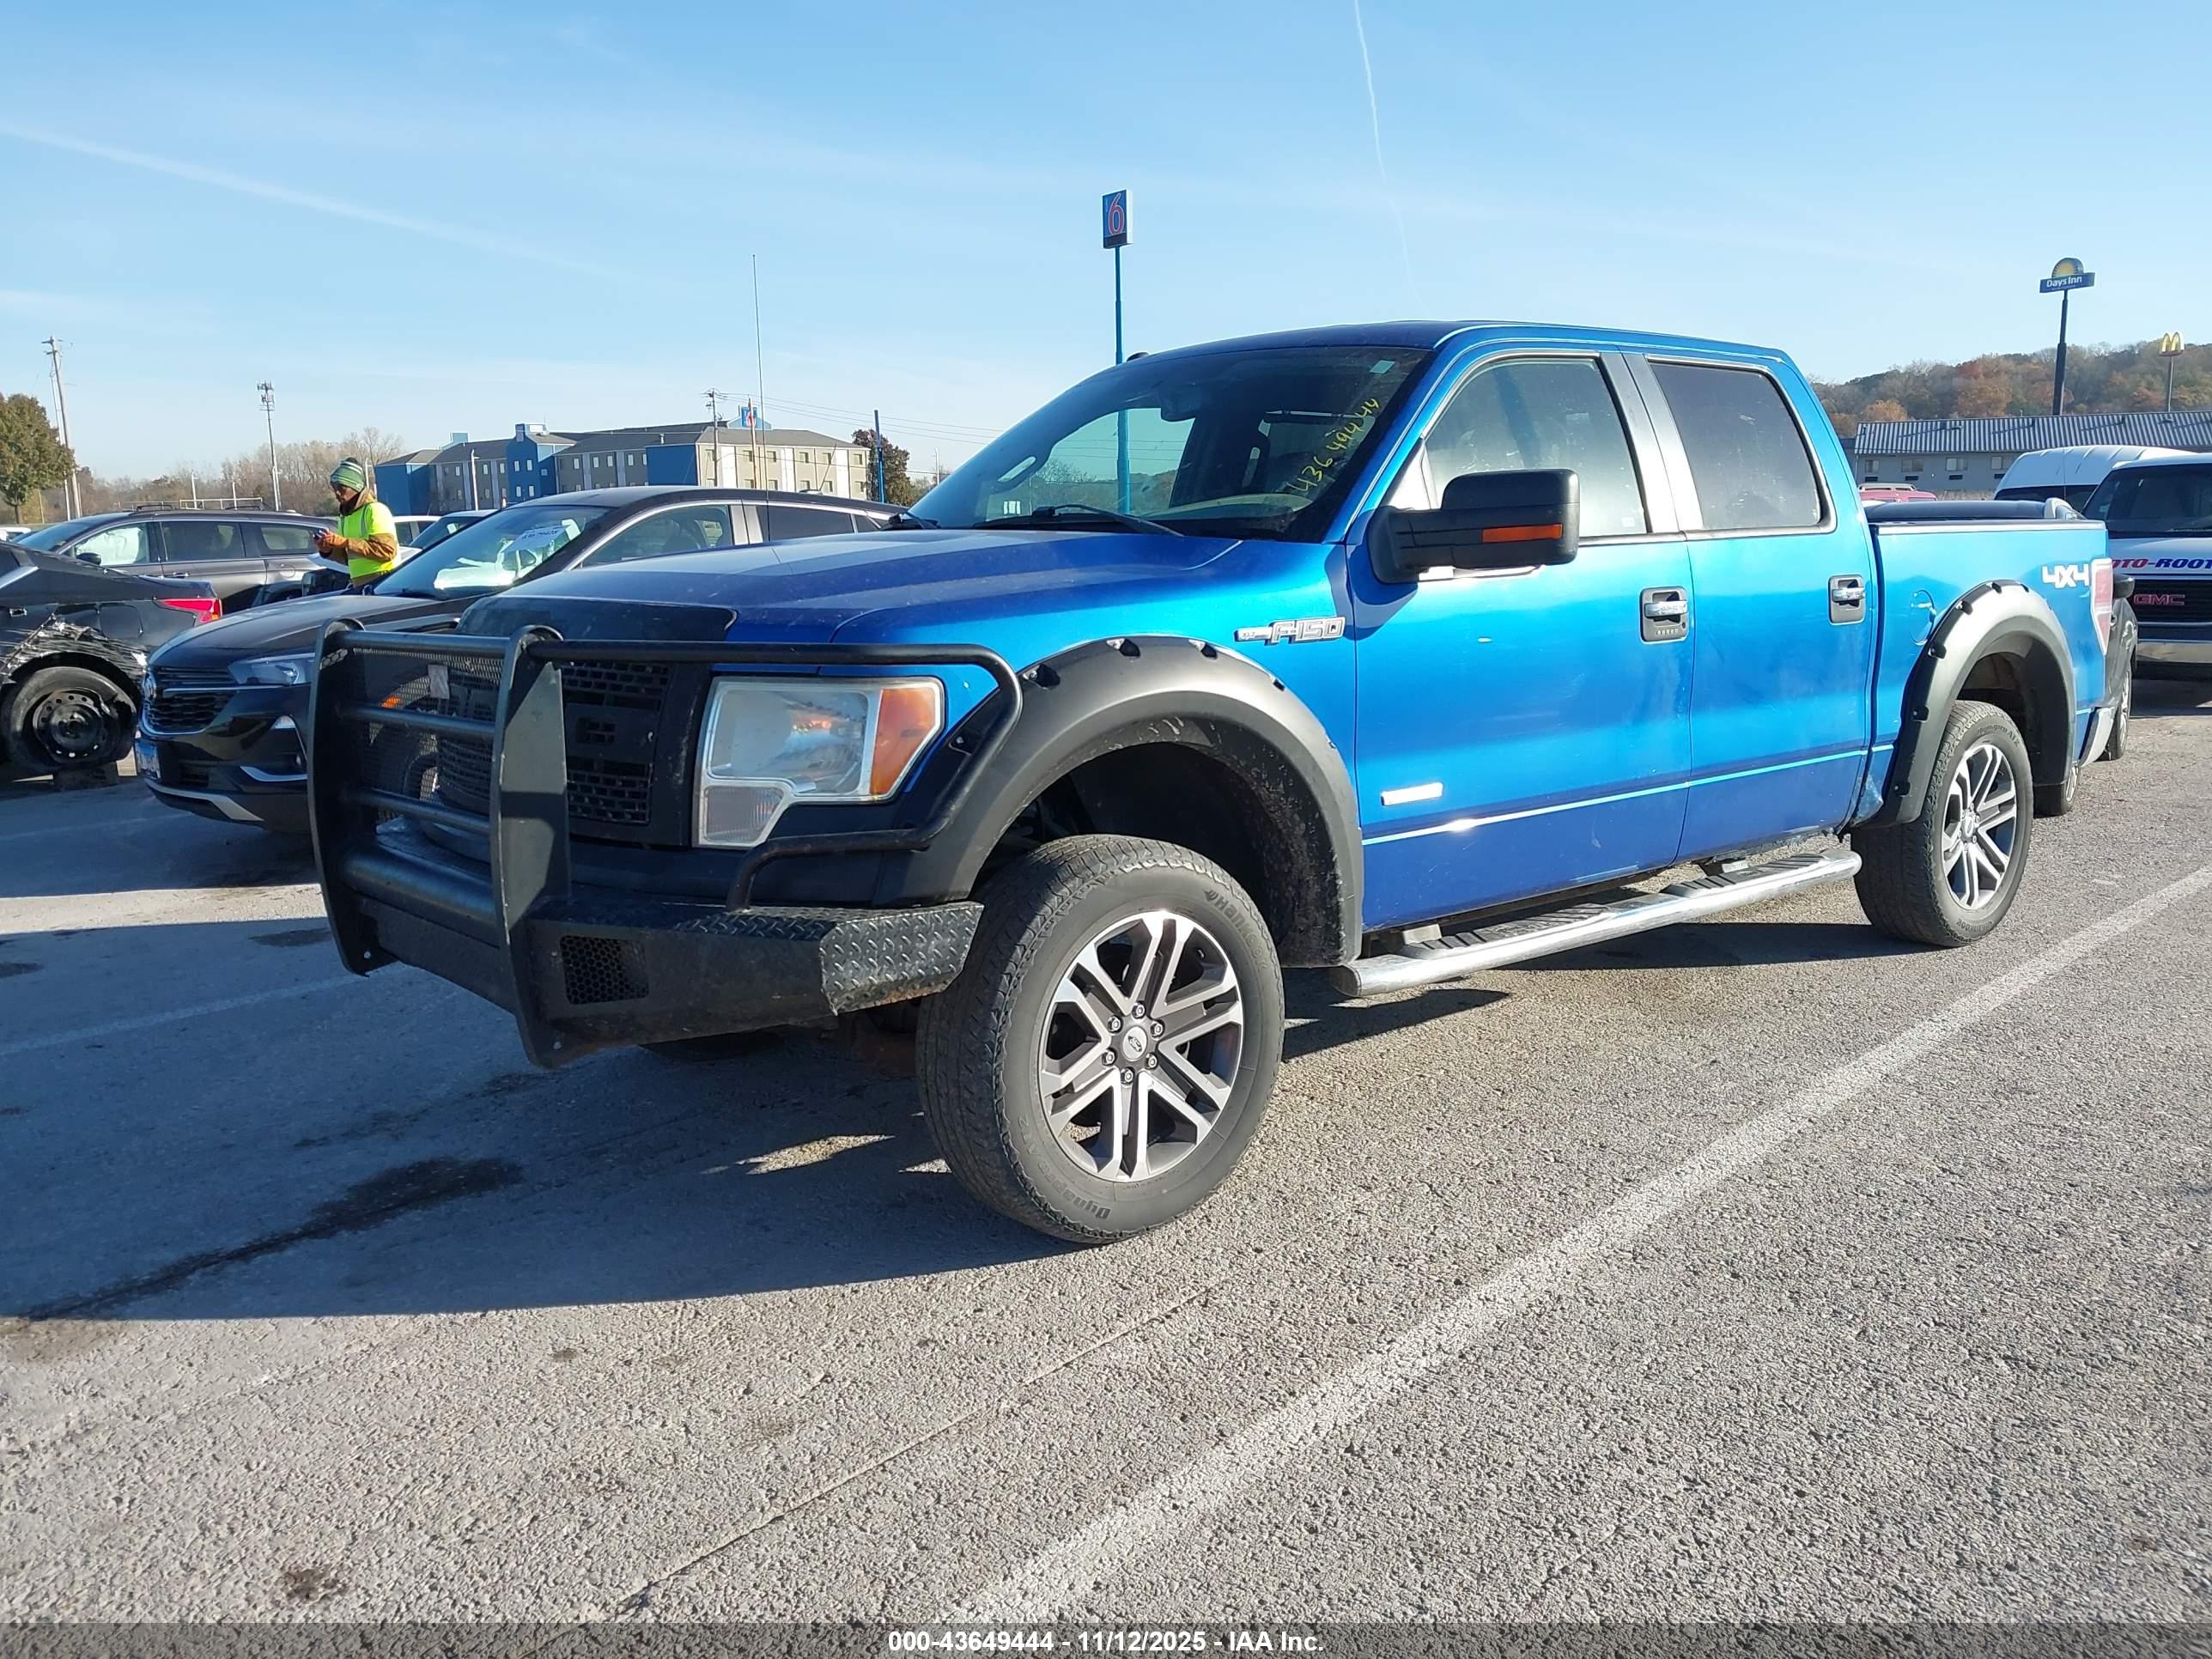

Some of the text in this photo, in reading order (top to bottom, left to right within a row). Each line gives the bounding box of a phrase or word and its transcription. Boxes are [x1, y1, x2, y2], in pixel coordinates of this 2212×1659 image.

[1108, 192, 1125, 235] 6
[2046, 276, 2082, 288] Days Inn
[2134, 594, 2185, 605] GMC
[1268, 617, 1346, 644] F-150
